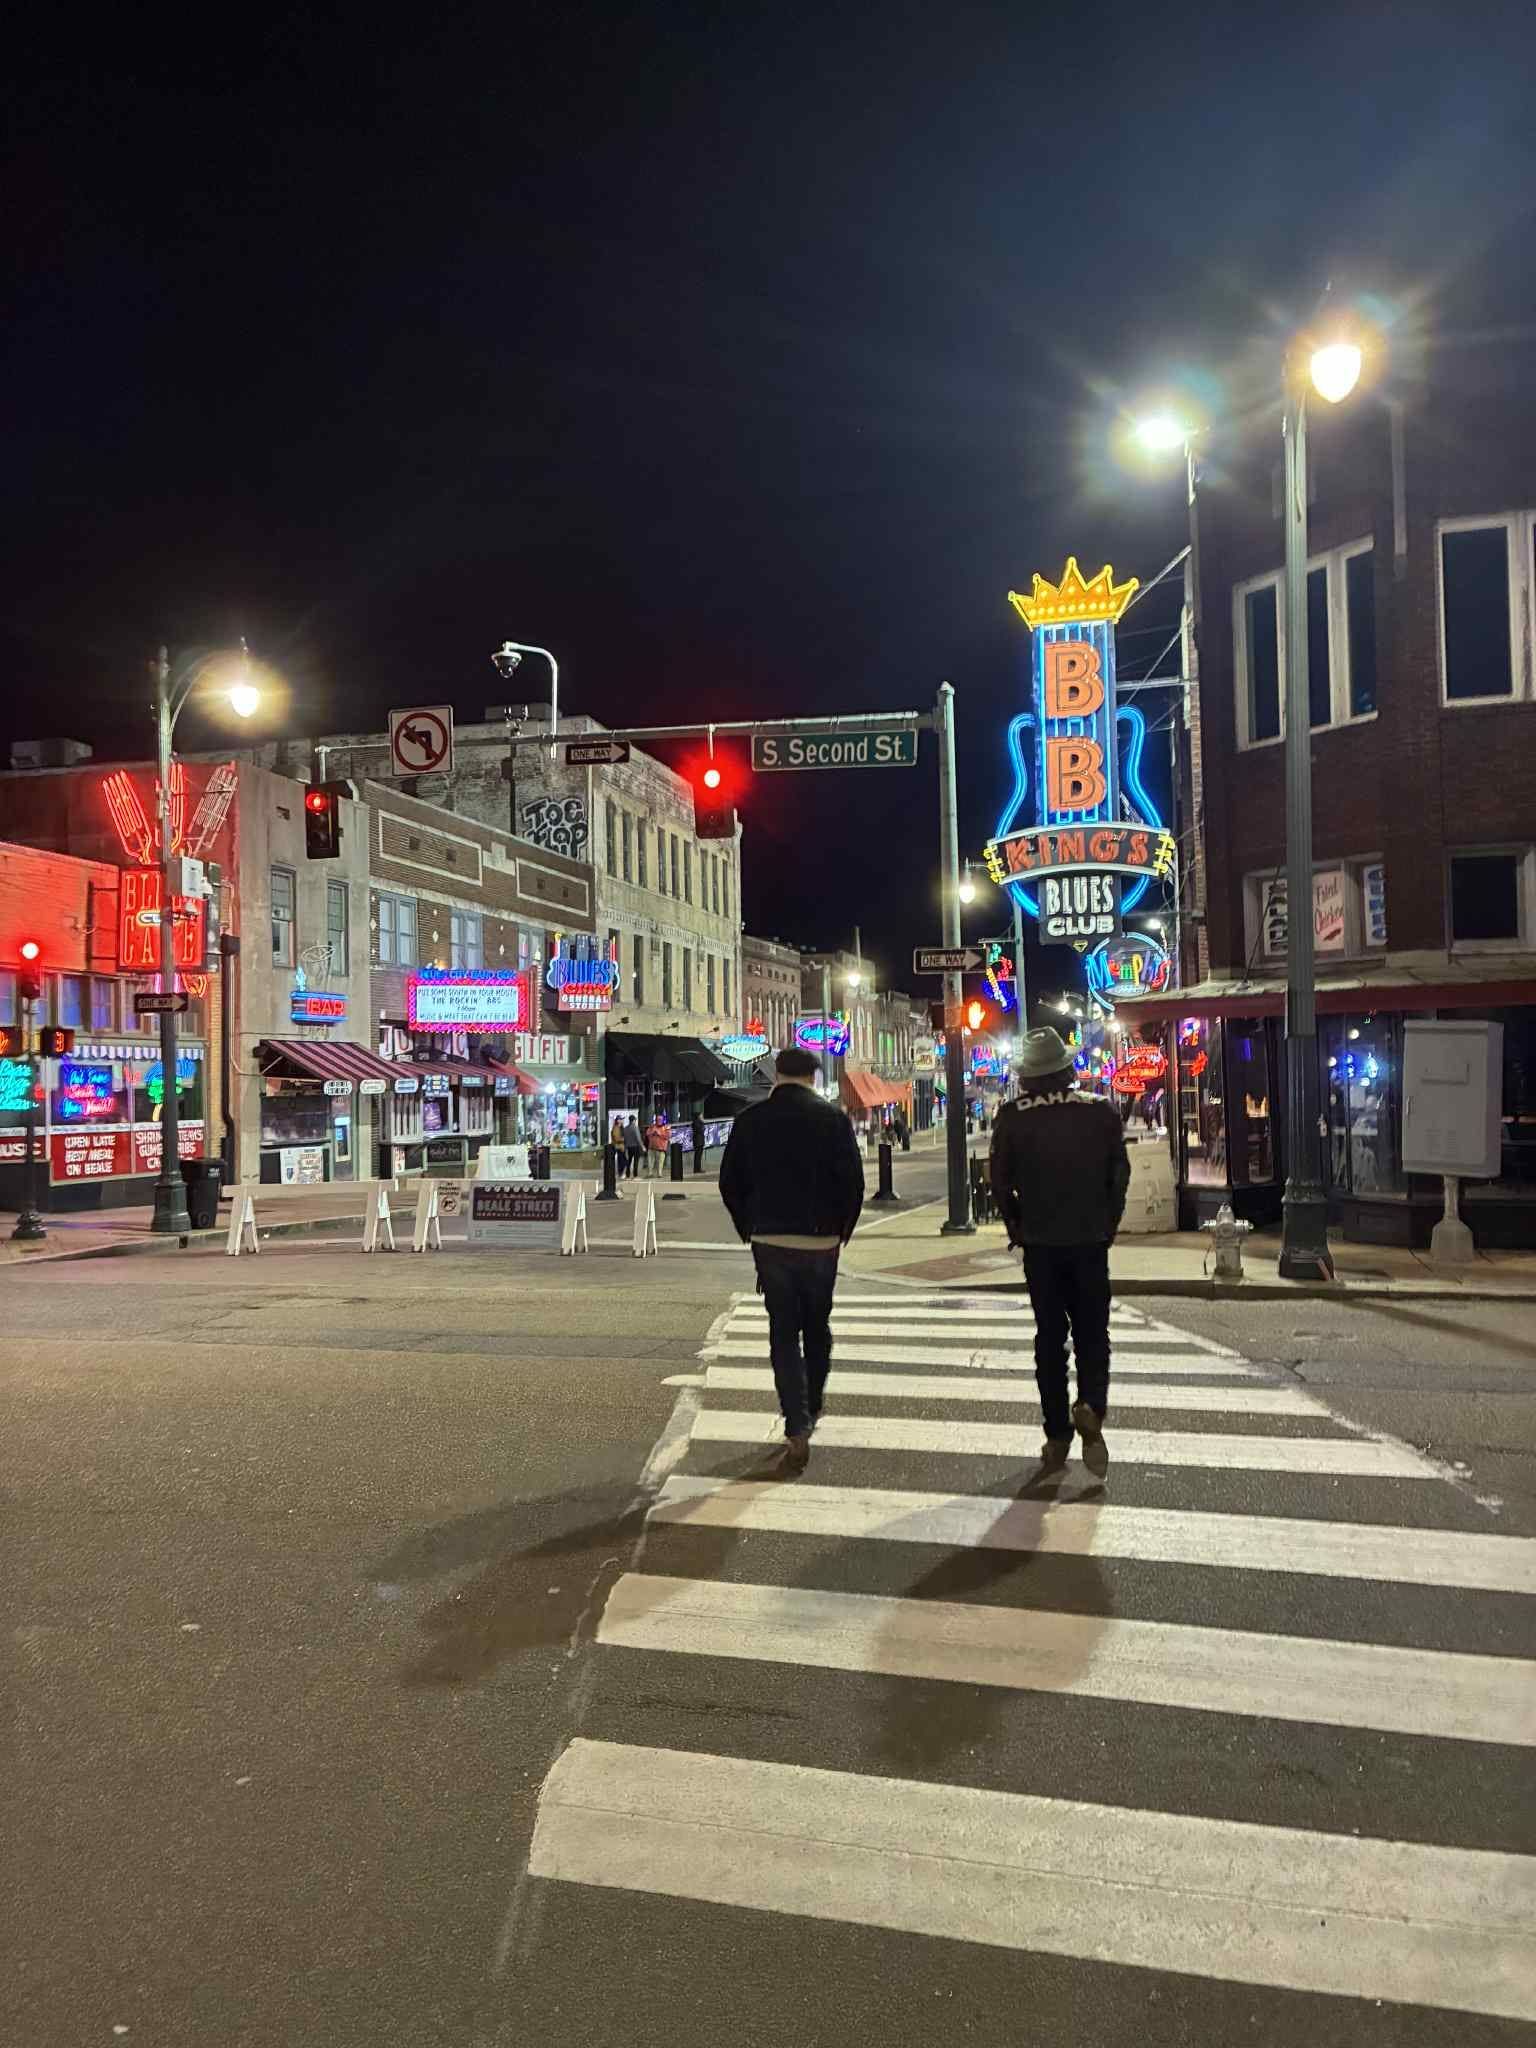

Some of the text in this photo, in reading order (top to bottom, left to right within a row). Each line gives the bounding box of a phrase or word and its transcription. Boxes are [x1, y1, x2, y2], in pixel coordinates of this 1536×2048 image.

[1045, 641, 1104, 719] B
[574, 748, 610, 760] ONE WAY
[763, 734, 906, 766] S. Second St.
[1046, 736, 1106, 812] B
[1004, 831, 1150, 873] KING'S
[1046, 875, 1114, 916] BLUES
[1047, 916, 1115, 937] CLUB
[124, 915, 195, 964] CAE
[922, 954, 965, 967] ONE WAY
[556, 960, 610, 986] BLUES
[564, 984, 611, 995] CITY
[306, 998, 345, 1016] BAR
[569, 1002, 601, 1010] STORE
[65, 1135, 116, 1149] OPEN LATE
[65, 1149, 114, 1163] BEST MEAL
[66, 1161, 112, 1176] ON BEALE
[514, 1200, 554, 1212] STREET
